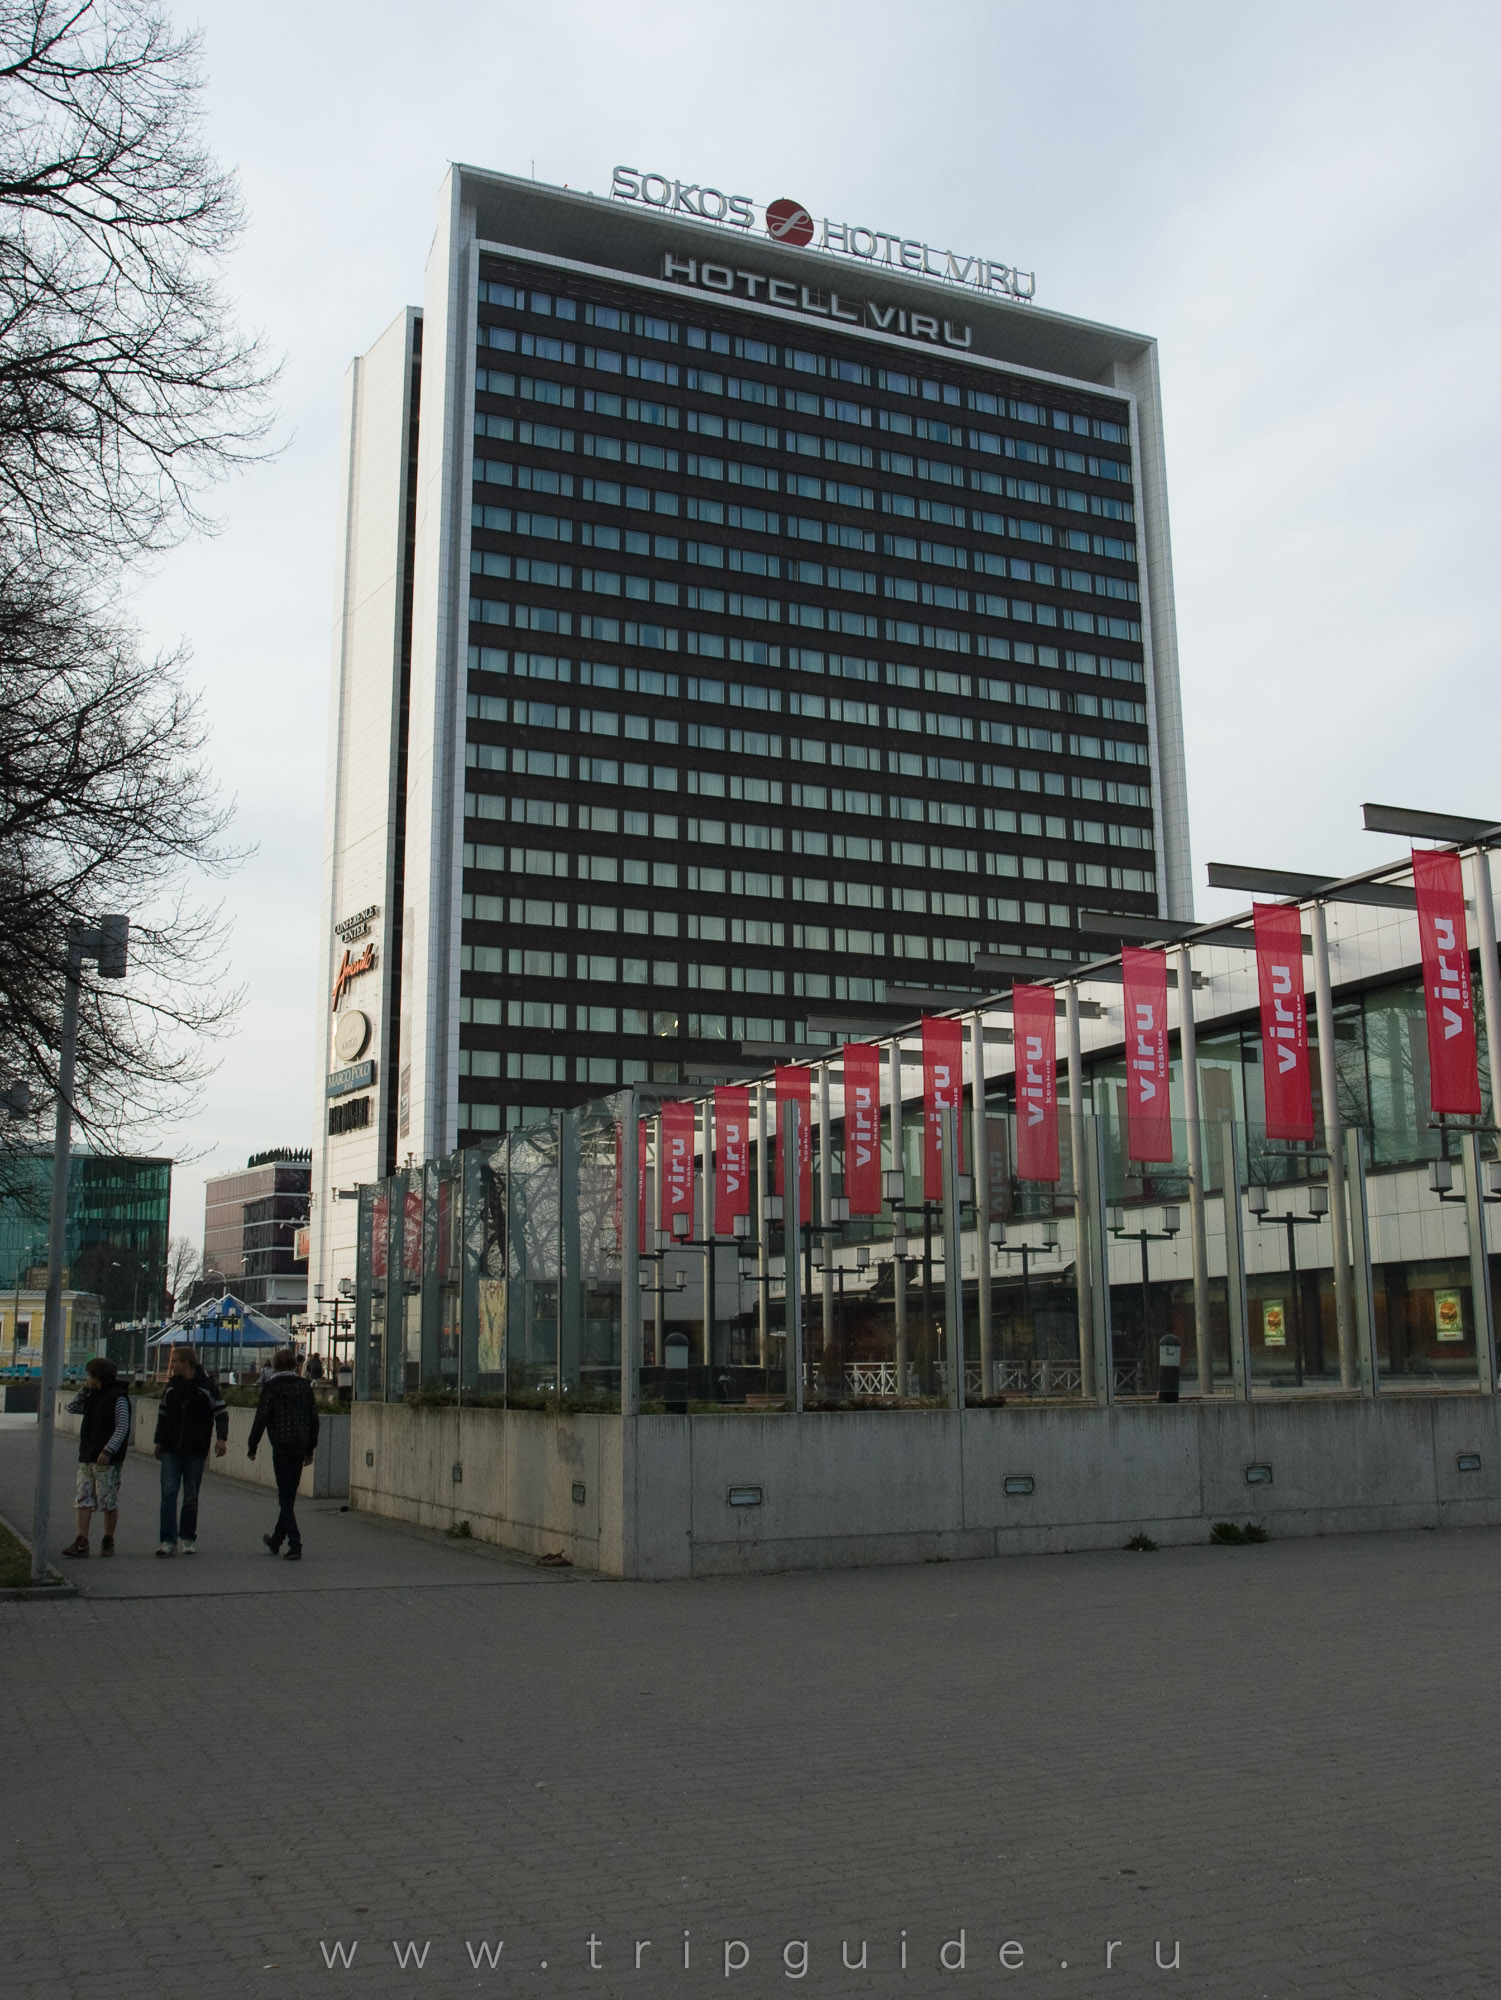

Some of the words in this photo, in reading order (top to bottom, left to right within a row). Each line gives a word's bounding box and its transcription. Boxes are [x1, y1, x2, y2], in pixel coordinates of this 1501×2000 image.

[612, 165, 755, 227] SOKOS
[823, 217, 941, 275] HOTEL
[945, 248, 1036, 299] VIRU
[664, 252, 858, 322] HOTELL
[866, 300, 973, 348] VIRU
[1269, 965, 1297, 1074] viru
[1433, 918, 1463, 1040] viru
[327, 1069, 352, 1090] MARCO
[351, 1063, 371, 1081] POLO
[1021, 1036, 1044, 1127] viru
[1133, 1004, 1156, 1103] viru
[1157, 1030, 1165, 1078] keskus
[667, 1138, 685, 1204] viru
[722, 1125, 740, 1194] viru
[850, 1087, 871, 1168] viru
